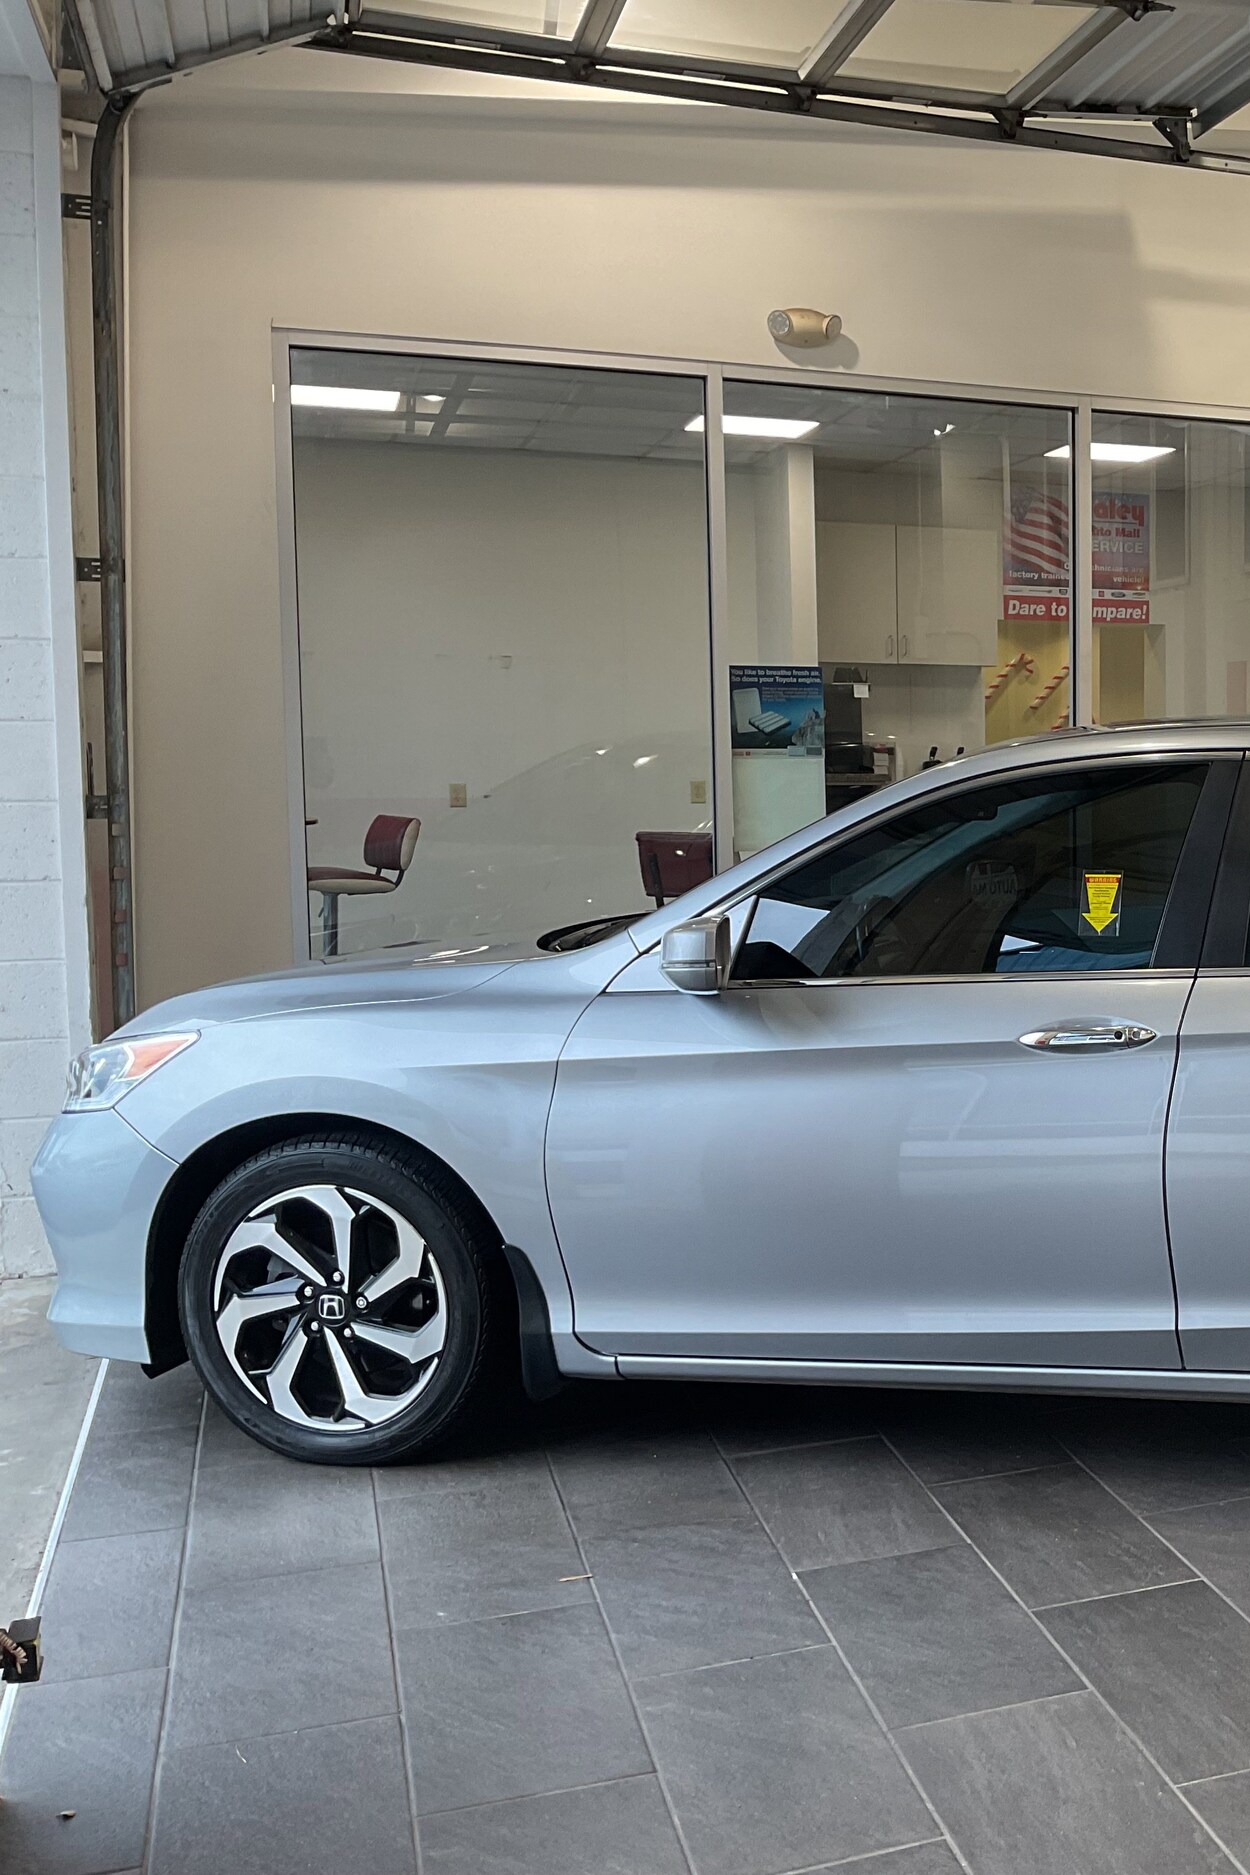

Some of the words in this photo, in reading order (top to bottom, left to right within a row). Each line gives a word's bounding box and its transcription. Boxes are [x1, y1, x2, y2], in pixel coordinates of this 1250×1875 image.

[1093, 498, 1145, 527] aley
[1115, 528, 1140, 538] Mall
[1092, 540, 1144, 553] ERVICE
[1009, 570, 1039, 579] factory
[1008, 600, 1046, 616] Dare
[1051, 602, 1067, 617] to
[1093, 605, 1147, 621] mpare!
[775, 676, 797, 684] Toyota
